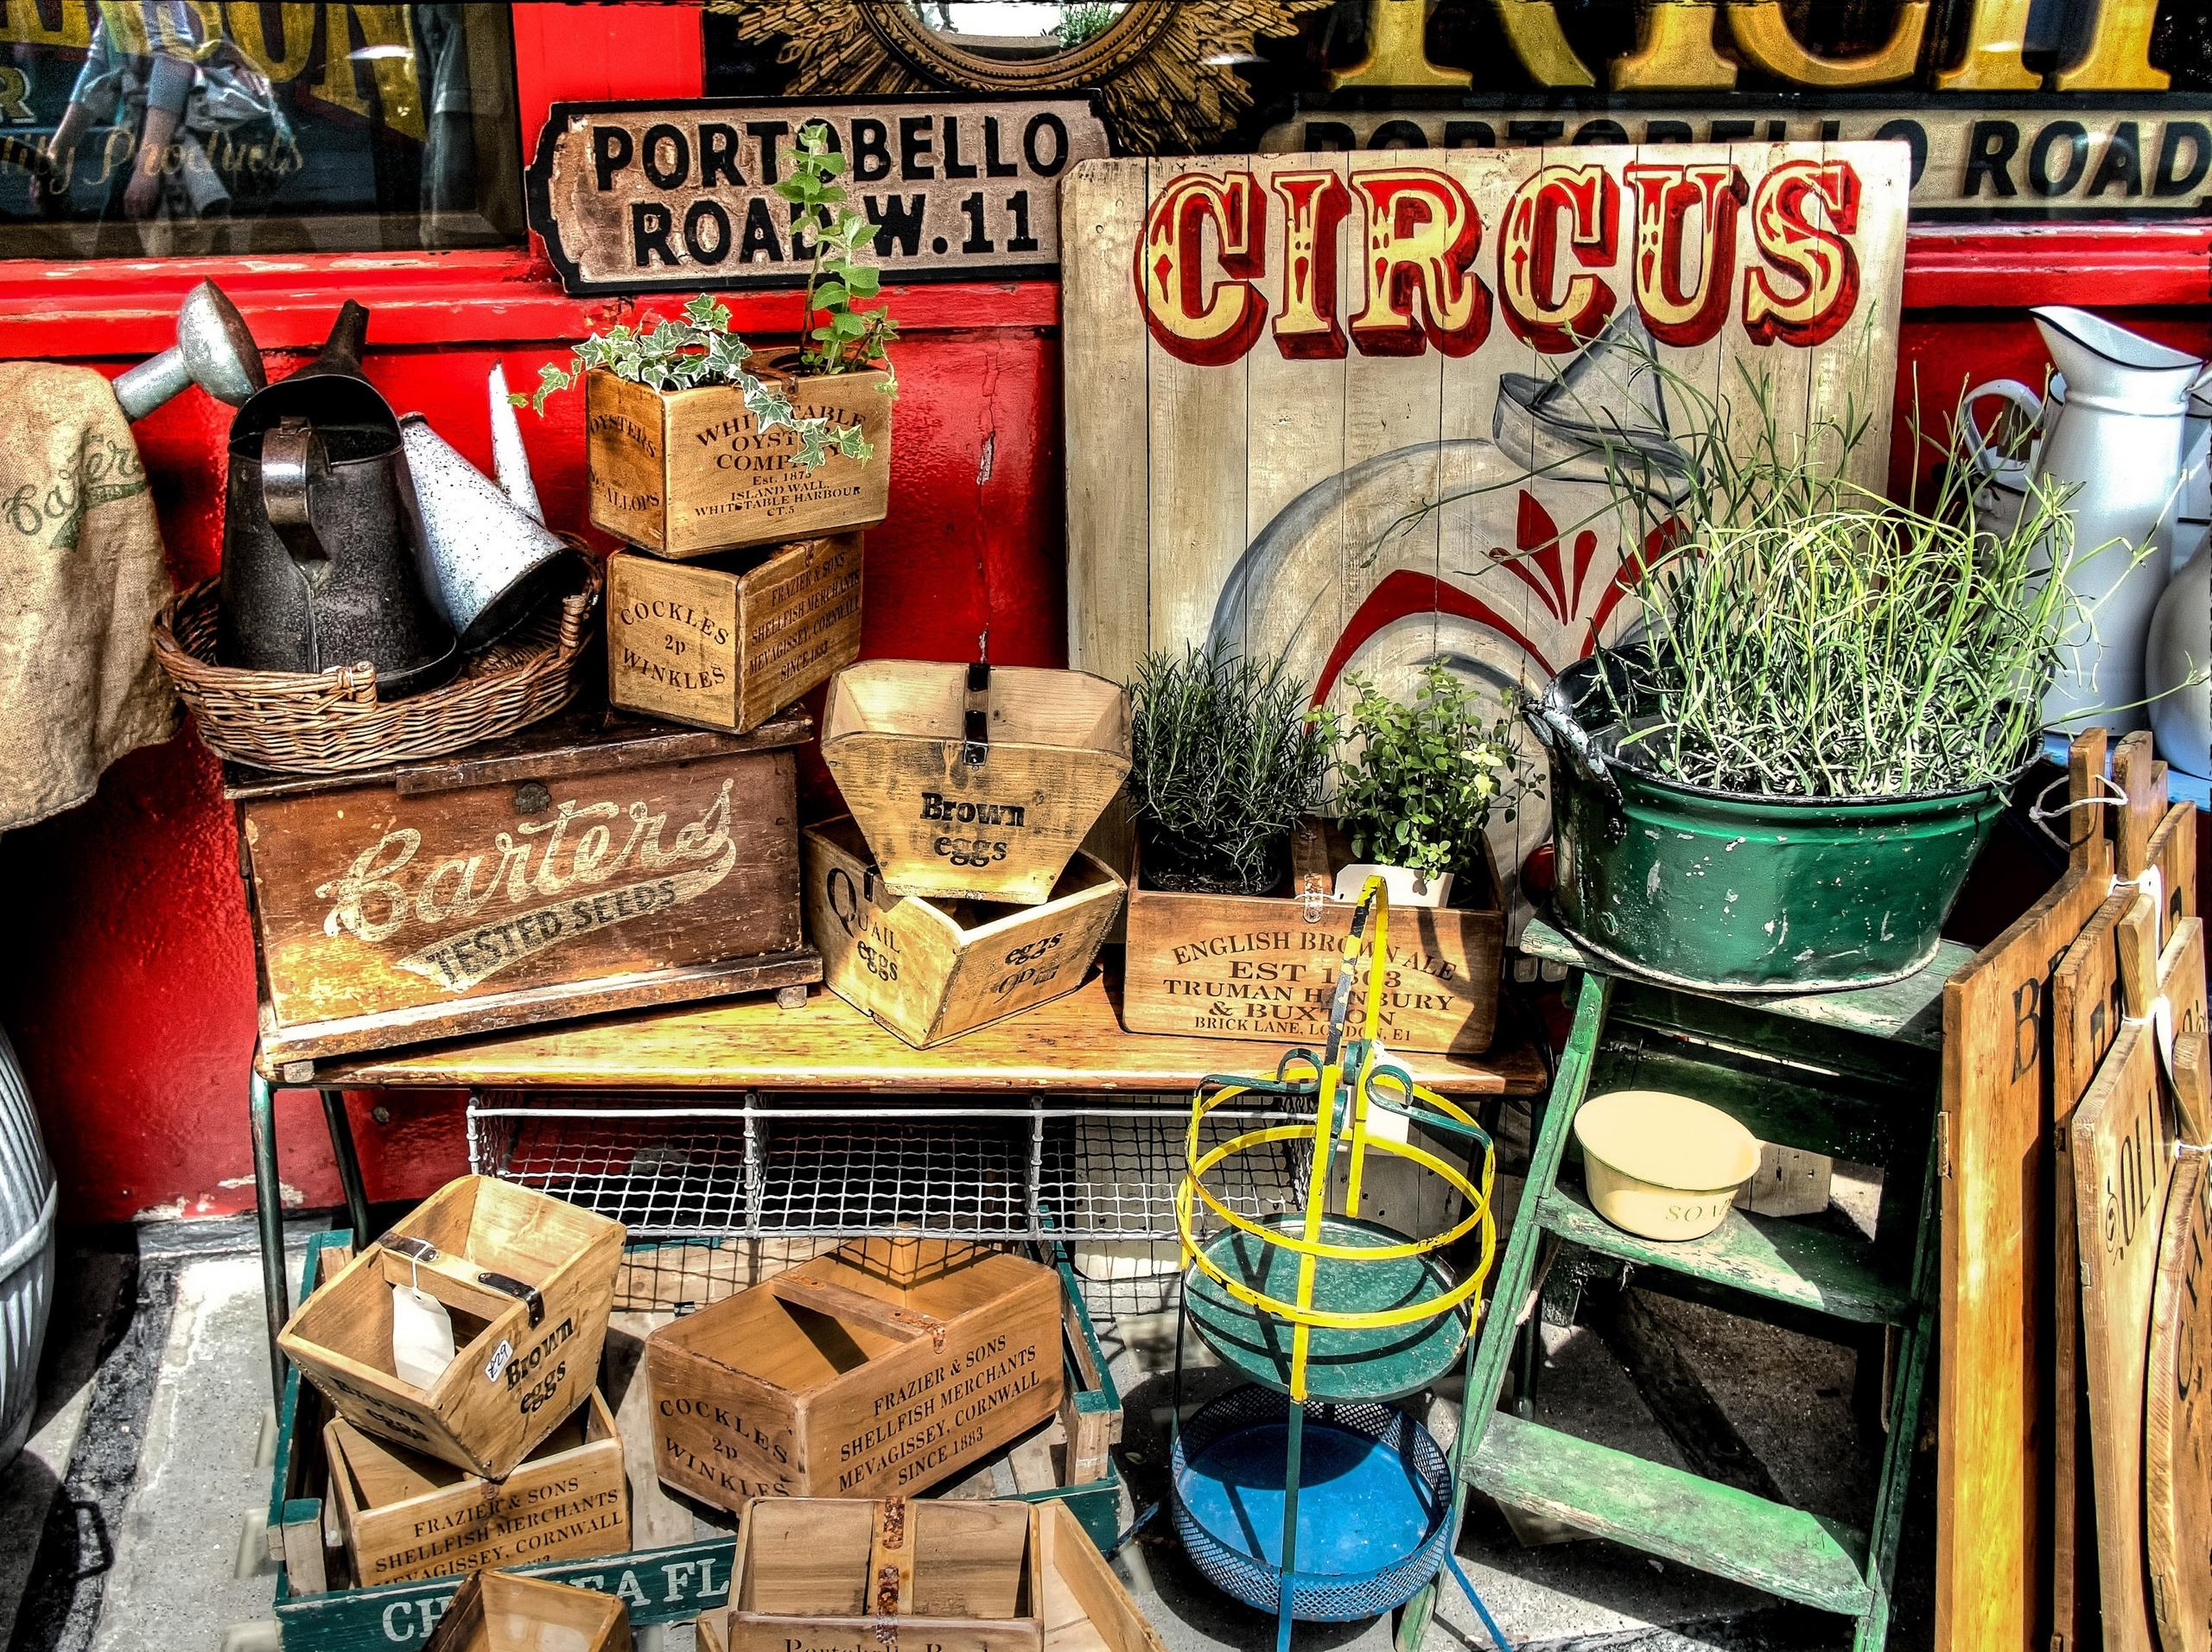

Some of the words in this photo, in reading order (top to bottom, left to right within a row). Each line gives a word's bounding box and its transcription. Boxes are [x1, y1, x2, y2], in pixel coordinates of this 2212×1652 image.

[593, 111, 1070, 191] PORTOBELLO
[1962, 120, 2212, 198] ROAD
[630, 198, 833, 267] ROAD
[863, 190, 1039, 257] W.11
[1135, 161, 1862, 367] CIRCUS
[589, 414, 656, 458] OYSTERS
[696, 403, 866, 448] WHITABLE
[732, 426, 831, 452] OYST
[716, 441, 842, 472] COMPY
[588, 467, 660, 511] SALLOPS
[695, 495, 790, 517] WHITSTABLE
[794, 486, 861, 504] HARBOUR
[731, 485, 785, 501] ISLAND
[789, 480, 830, 493] WALL.
[753, 476, 777, 486] Est.
[771, 569, 815, 607] FRAZIER
[823, 551, 845, 577] SONS
[620, 599, 729, 645] COCKLES
[751, 600, 804, 646] SHELLFISH
[807, 569, 860, 614] MERCHANTS
[812, 594, 860, 636] CORNWALL
[664, 635, 685, 655] 2p
[780, 650, 808, 682] SINCE
[810, 639, 829, 663] 1883
[622, 646, 726, 690] WINKLES
[919, 792, 1026, 828] Brown
[315, 778, 735, 942] Carters
[933, 835, 1008, 867] eggs
[426, 911, 563, 985] TESTED
[573, 880, 677, 932] SEEDS
[826, 867, 901, 954] QUAIL
[857, 938, 899, 982] eggs
[1005, 933, 1064, 965] eggs
[1171, 931, 1290, 966] ENGLISH
[1402, 951, 1458, 982] ALE
[1229, 961, 1307, 982] EST
[1163, 979, 1294, 1001] TRUMAN
[1194, 1016, 1248, 1031] BRICK
[1309, 1023, 1387, 1041] LODN,
[1392, 1028, 1410, 1041] E1
[1209, 1001, 1233, 1017] &
[1248, 1003, 1396, 1026] BUXTON
[488, 1344, 509, 1378] £29
[505, 1318, 573, 1392] Brown
[874, 1367, 946, 1416] FRAZIER
[950, 1357, 963, 1375] &
[965, 1334, 1007, 1366] SONS
[520, 1361, 566, 1414] eggs
[840, 1398, 935, 1462] SHELLFISH
[940, 1344, 1037, 1408] MERCHANTS
[954, 1369, 1040, 1427] CORNWALL
[659, 1398, 790, 1465] COCKLES
[712, 1437, 738, 1460] 2p
[663, 1437, 792, 1496] WINKLES
[898, 1446, 948, 1487] SINCE
[953, 1426, 984, 1458] 1883
[414, 1498, 501, 1538] FRAZIER
[528, 1477, 579, 1503] SONS
[373, 1546, 510, 1586] VAGISSEY,
[516, 1511, 623, 1554] CORNWALL
[376, 1527, 489, 1573] SHELLFISH
[497, 1490, 619, 1538] MERCHANTS
